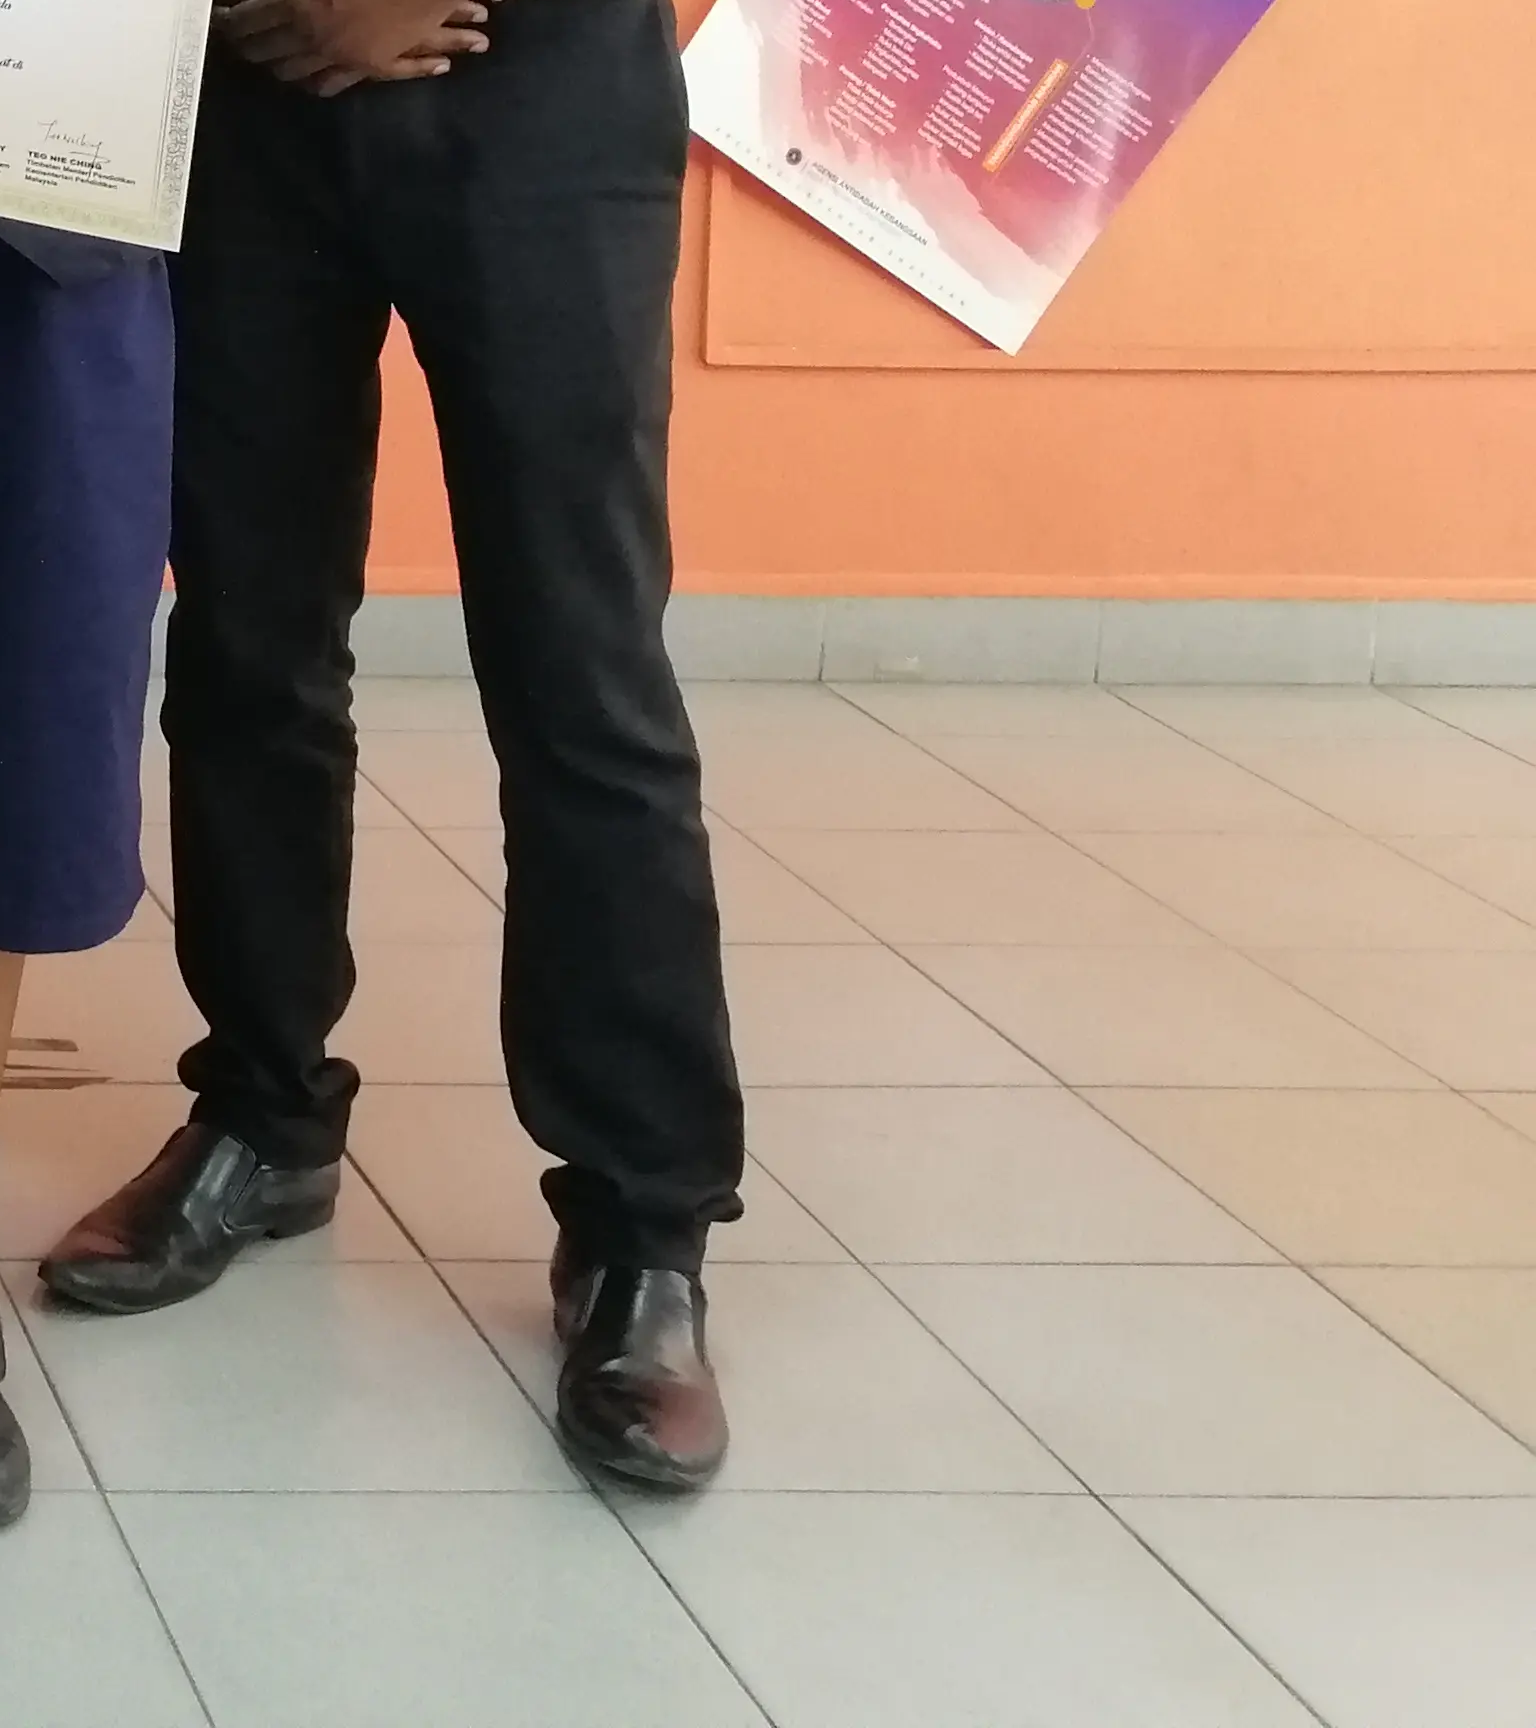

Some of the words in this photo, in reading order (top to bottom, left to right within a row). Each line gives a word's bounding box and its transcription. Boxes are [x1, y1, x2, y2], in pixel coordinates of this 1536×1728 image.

[28, 150, 47, 159] TEO
[49, 155, 66, 163] NIE
[69, 158, 101, 170] CHING
